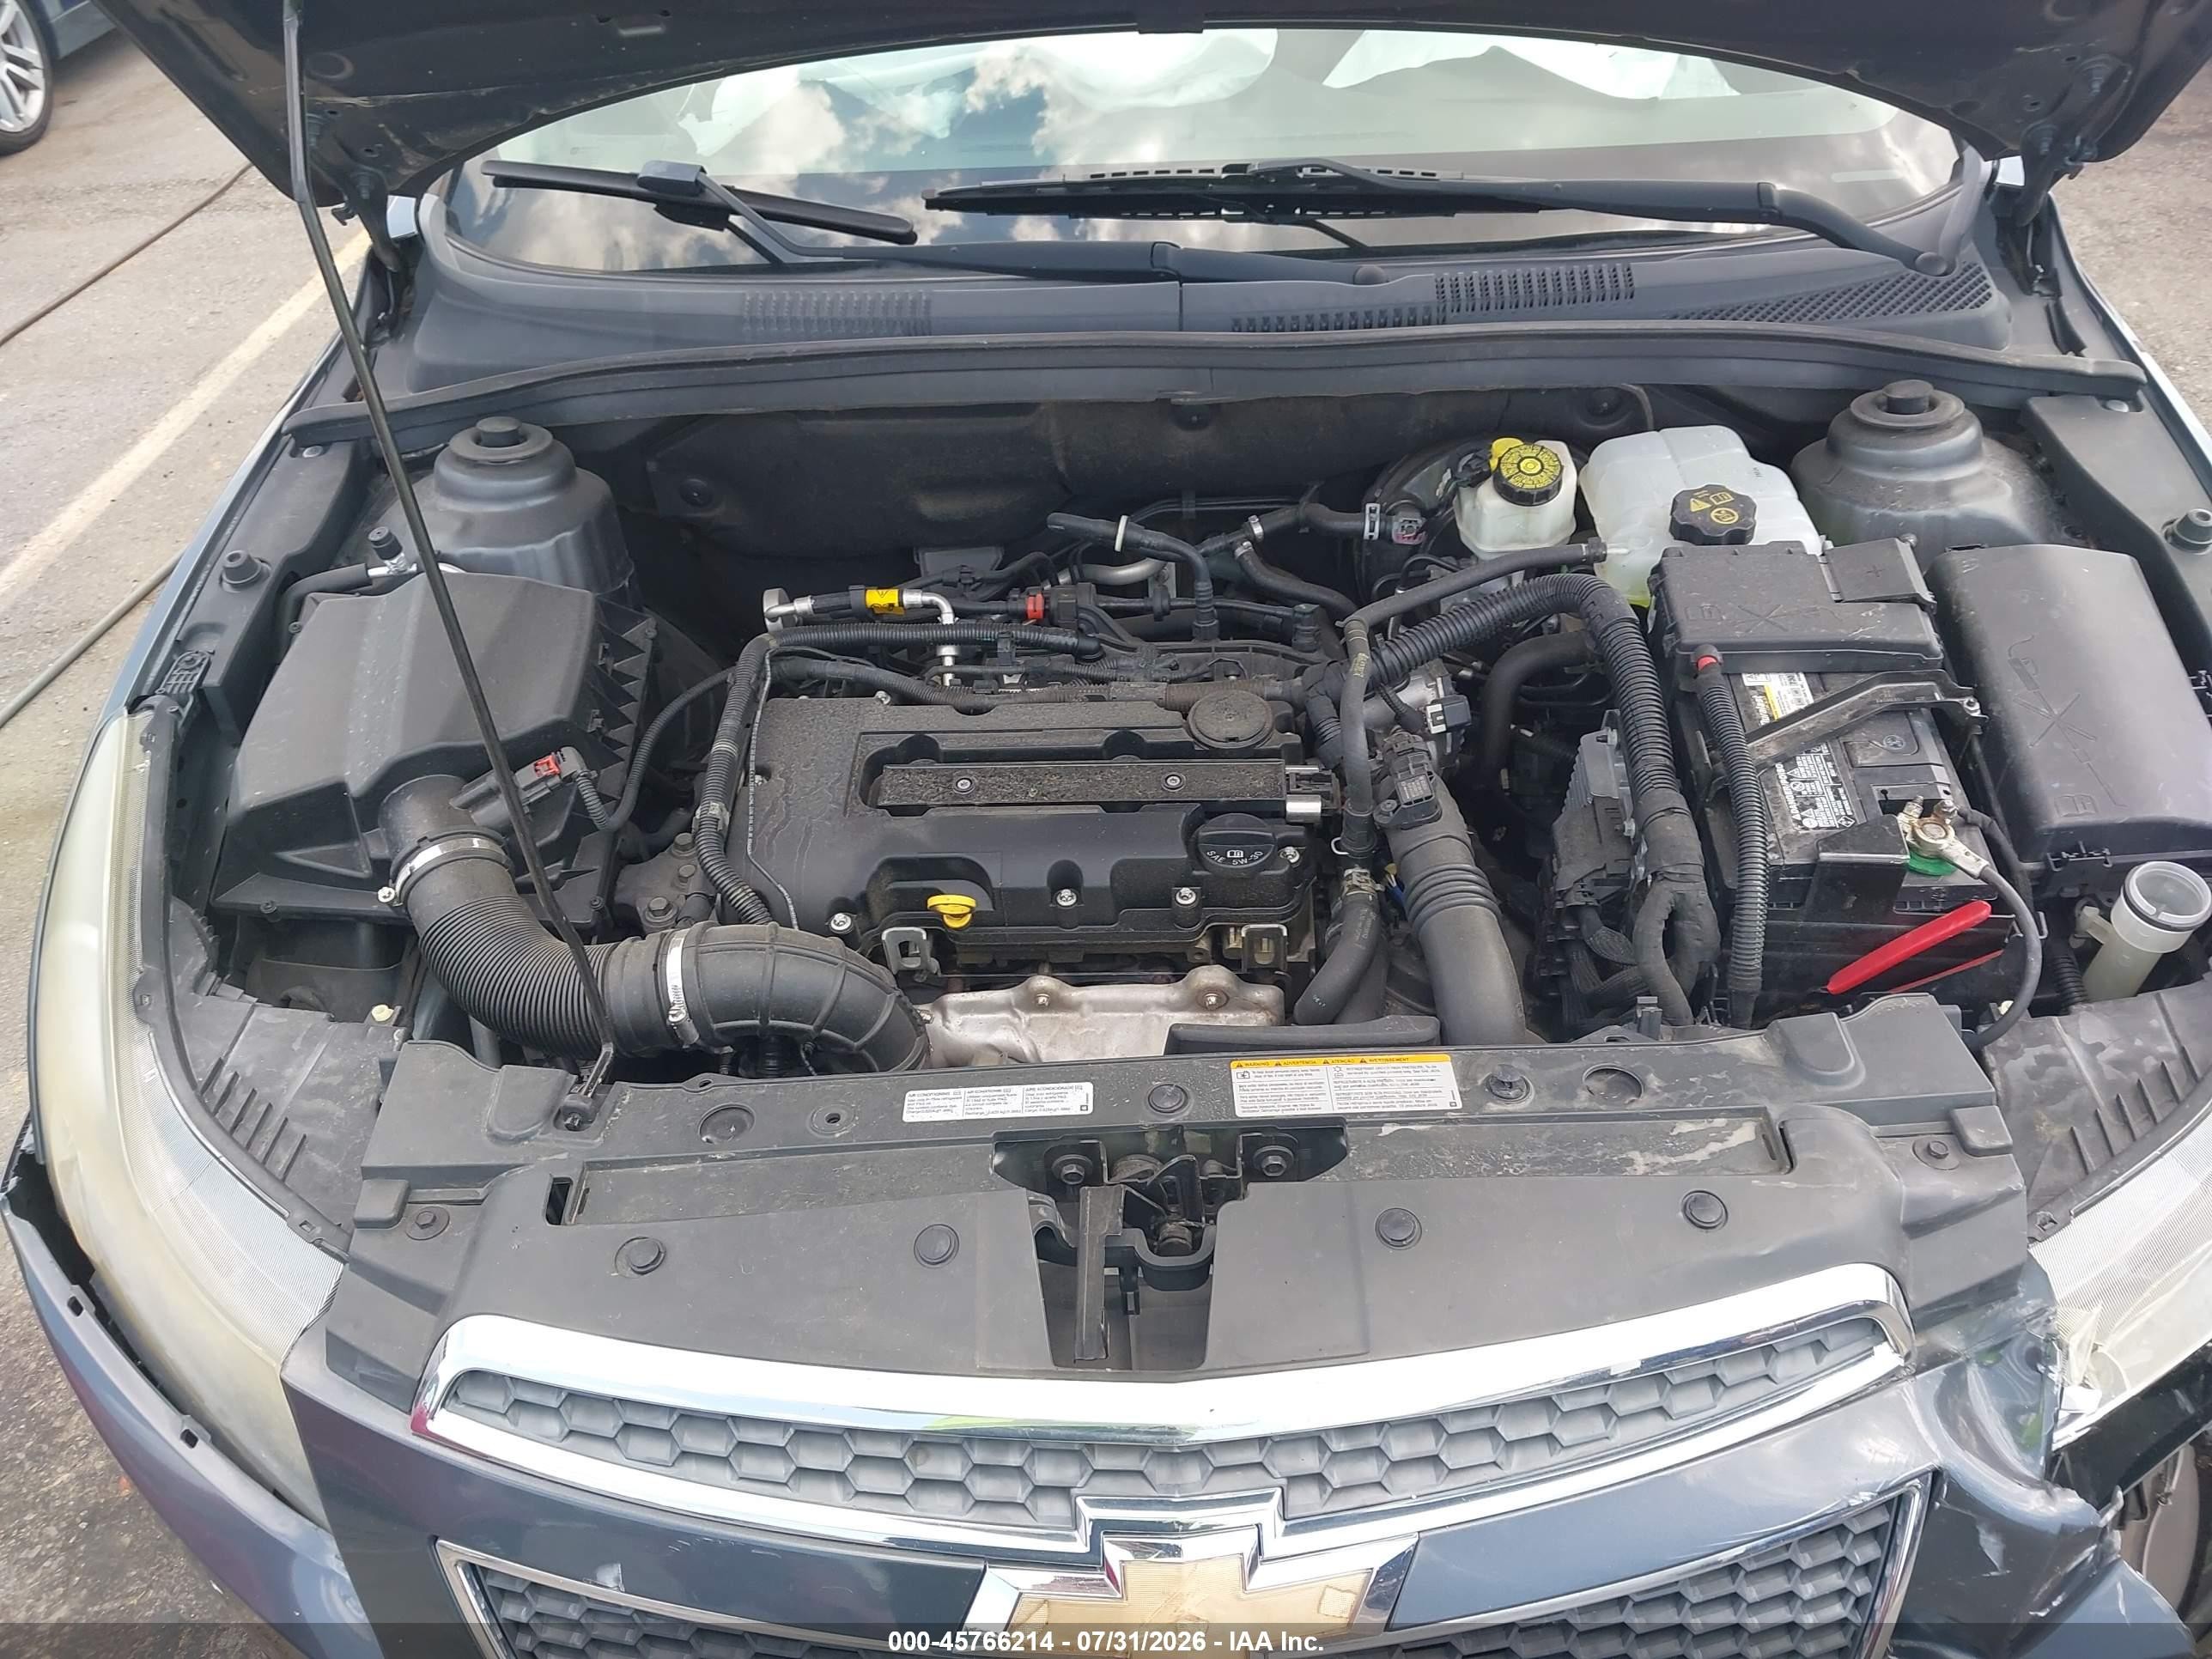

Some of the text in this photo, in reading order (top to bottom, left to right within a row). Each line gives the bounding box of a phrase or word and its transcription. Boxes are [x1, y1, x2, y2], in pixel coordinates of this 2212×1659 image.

[1775, 763, 1800, 813] DANGER/POISO
[1206, 849, 1264, 866] SAE 5W-30
